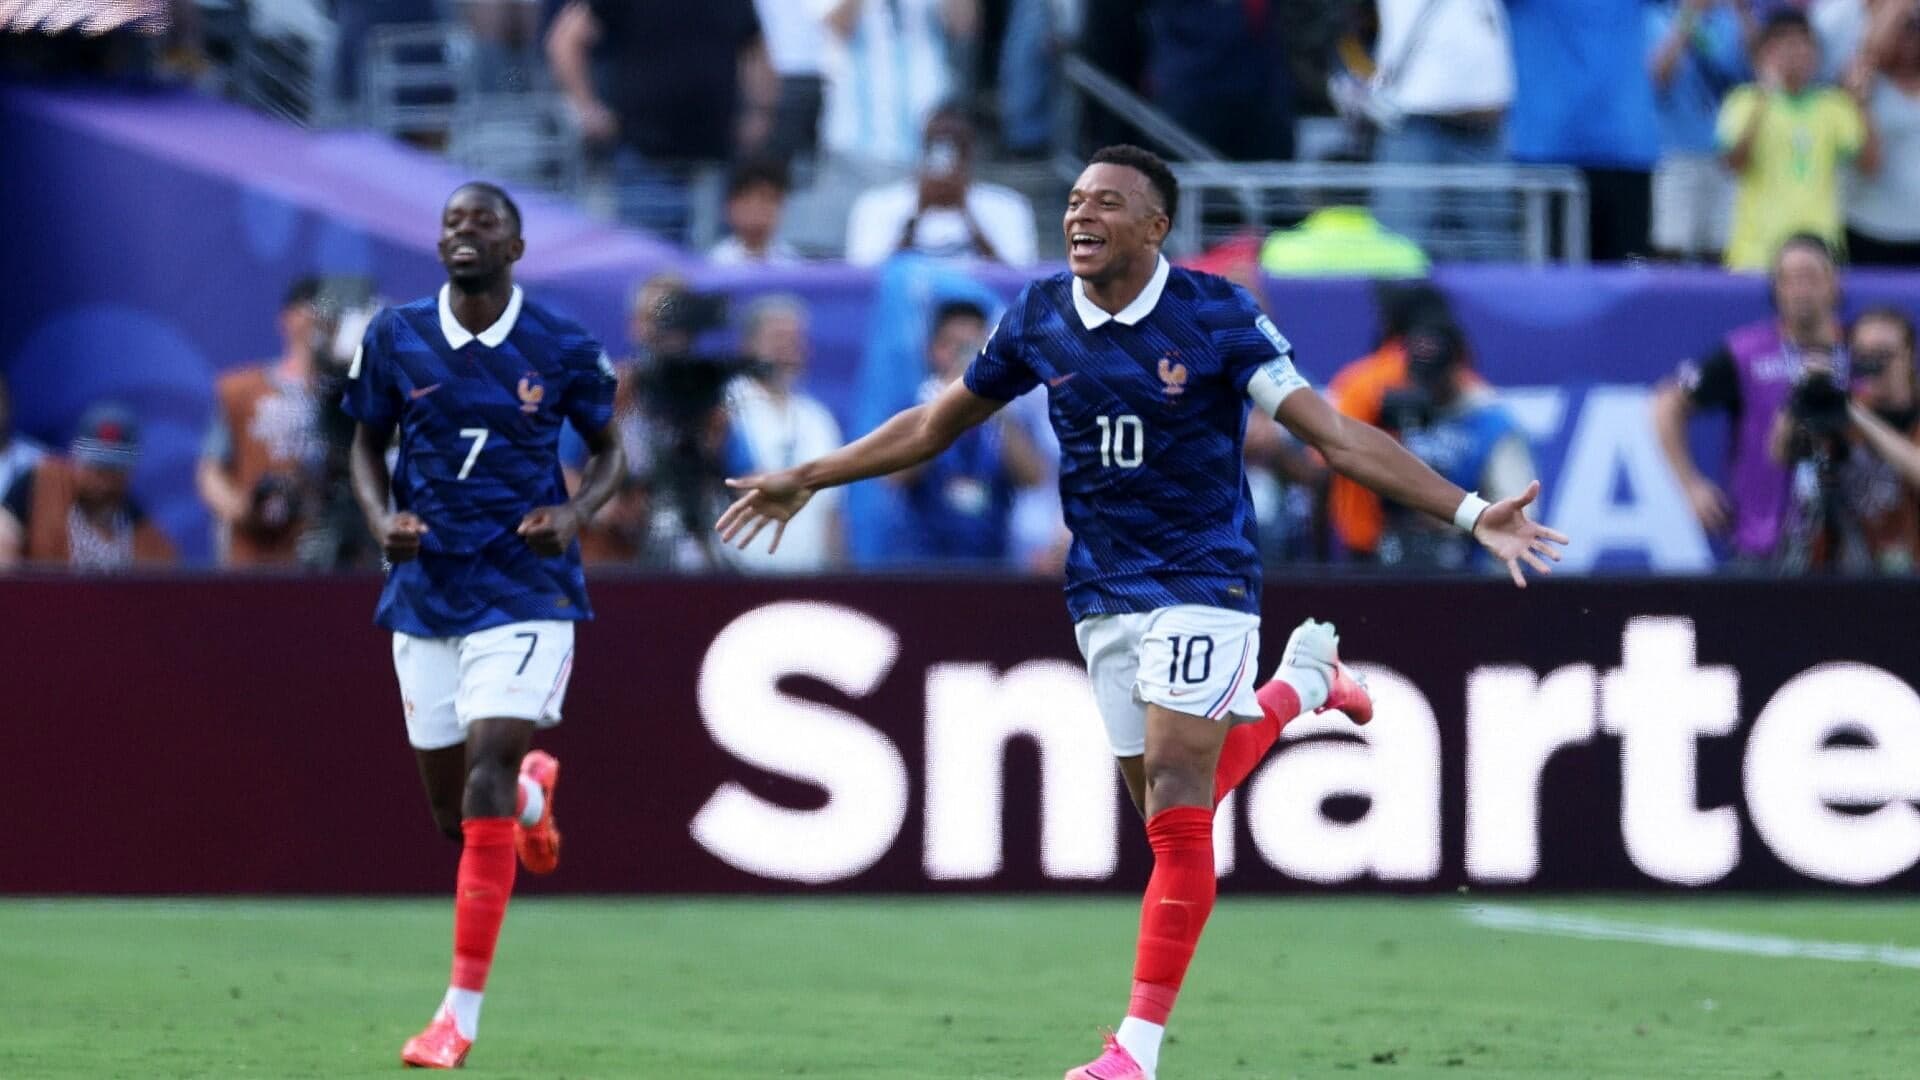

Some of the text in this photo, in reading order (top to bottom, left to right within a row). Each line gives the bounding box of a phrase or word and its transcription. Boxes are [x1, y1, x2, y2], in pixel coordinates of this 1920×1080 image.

[456, 428, 489, 481] 7
[1096, 414, 1144, 468] 10
[514, 631, 538, 676] 7
[1167, 634, 1214, 685] 10
